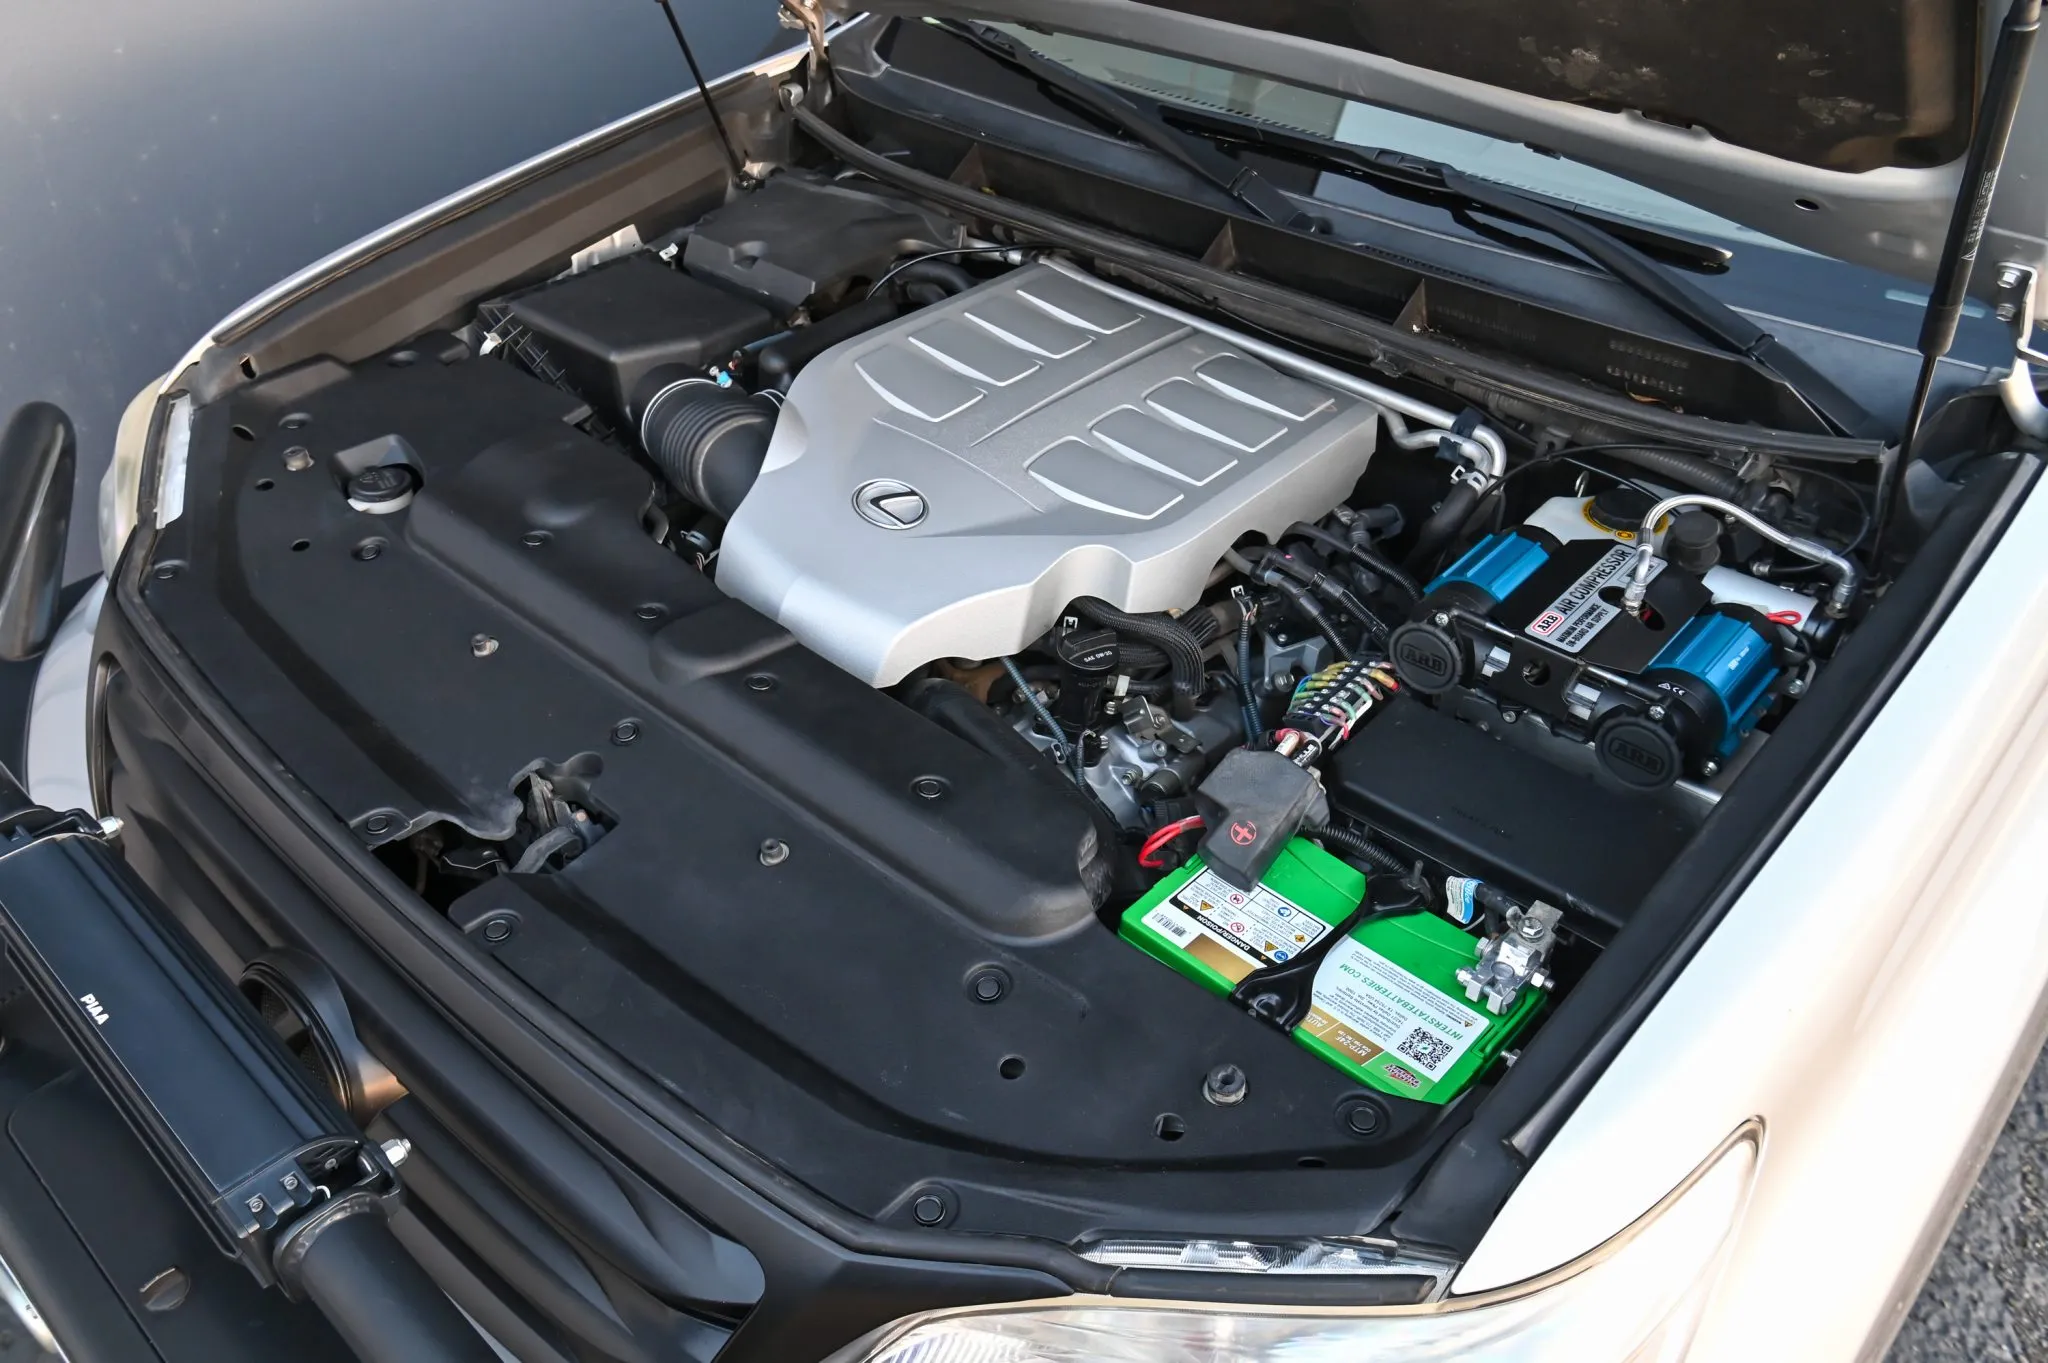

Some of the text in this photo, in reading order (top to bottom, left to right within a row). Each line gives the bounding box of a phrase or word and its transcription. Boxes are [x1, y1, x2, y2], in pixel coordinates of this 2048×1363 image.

[1538, 614, 1559, 632] ARB
[1555, 598, 1579, 615] AIR
[1569, 548, 1632, 601] COMPRESSOR
[1572, 602, 1601, 629] PERFORMANCE
[1593, 608, 1609, 624] SUPPLY
[1405, 647, 1442, 672] ARB
[1196, 914, 1250, 951] DANGER/POISON
[80, 993, 109, 1025] PIAA
[1338, 961, 1463, 1041] INTERSTATEBATTERIES.COM
[1333, 1033, 1368, 1057] MTP-24F
[1383, 1065, 1417, 1088] INTERSTATE
